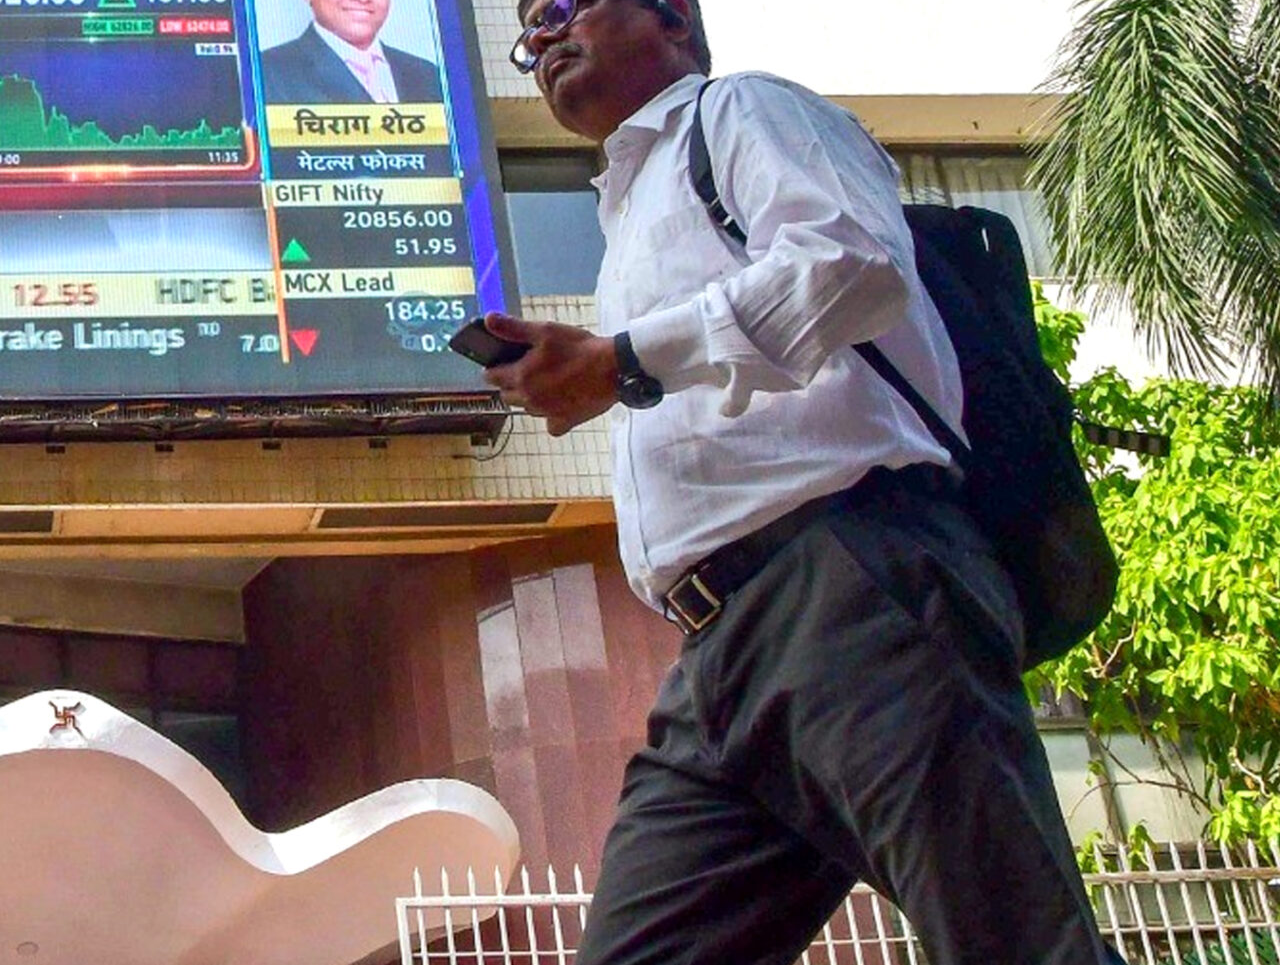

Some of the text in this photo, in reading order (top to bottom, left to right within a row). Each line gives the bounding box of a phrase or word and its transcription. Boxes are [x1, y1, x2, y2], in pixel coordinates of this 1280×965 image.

[294, 108, 426, 136] चिराग शेठ
[298, 149, 426, 172] मेटल्स फोकस
[276, 184, 384, 205] GIFT Nifty
[343, 210, 453, 229] 20856.00
[395, 238, 457, 255] 51.95
[14, 283, 100, 307] 12.55
[156, 278, 237, 304] HDFC
[285, 272, 395, 293] MCX Lead
[385, 300, 465, 320] 184.25
[73, 322, 185, 356] Linings
